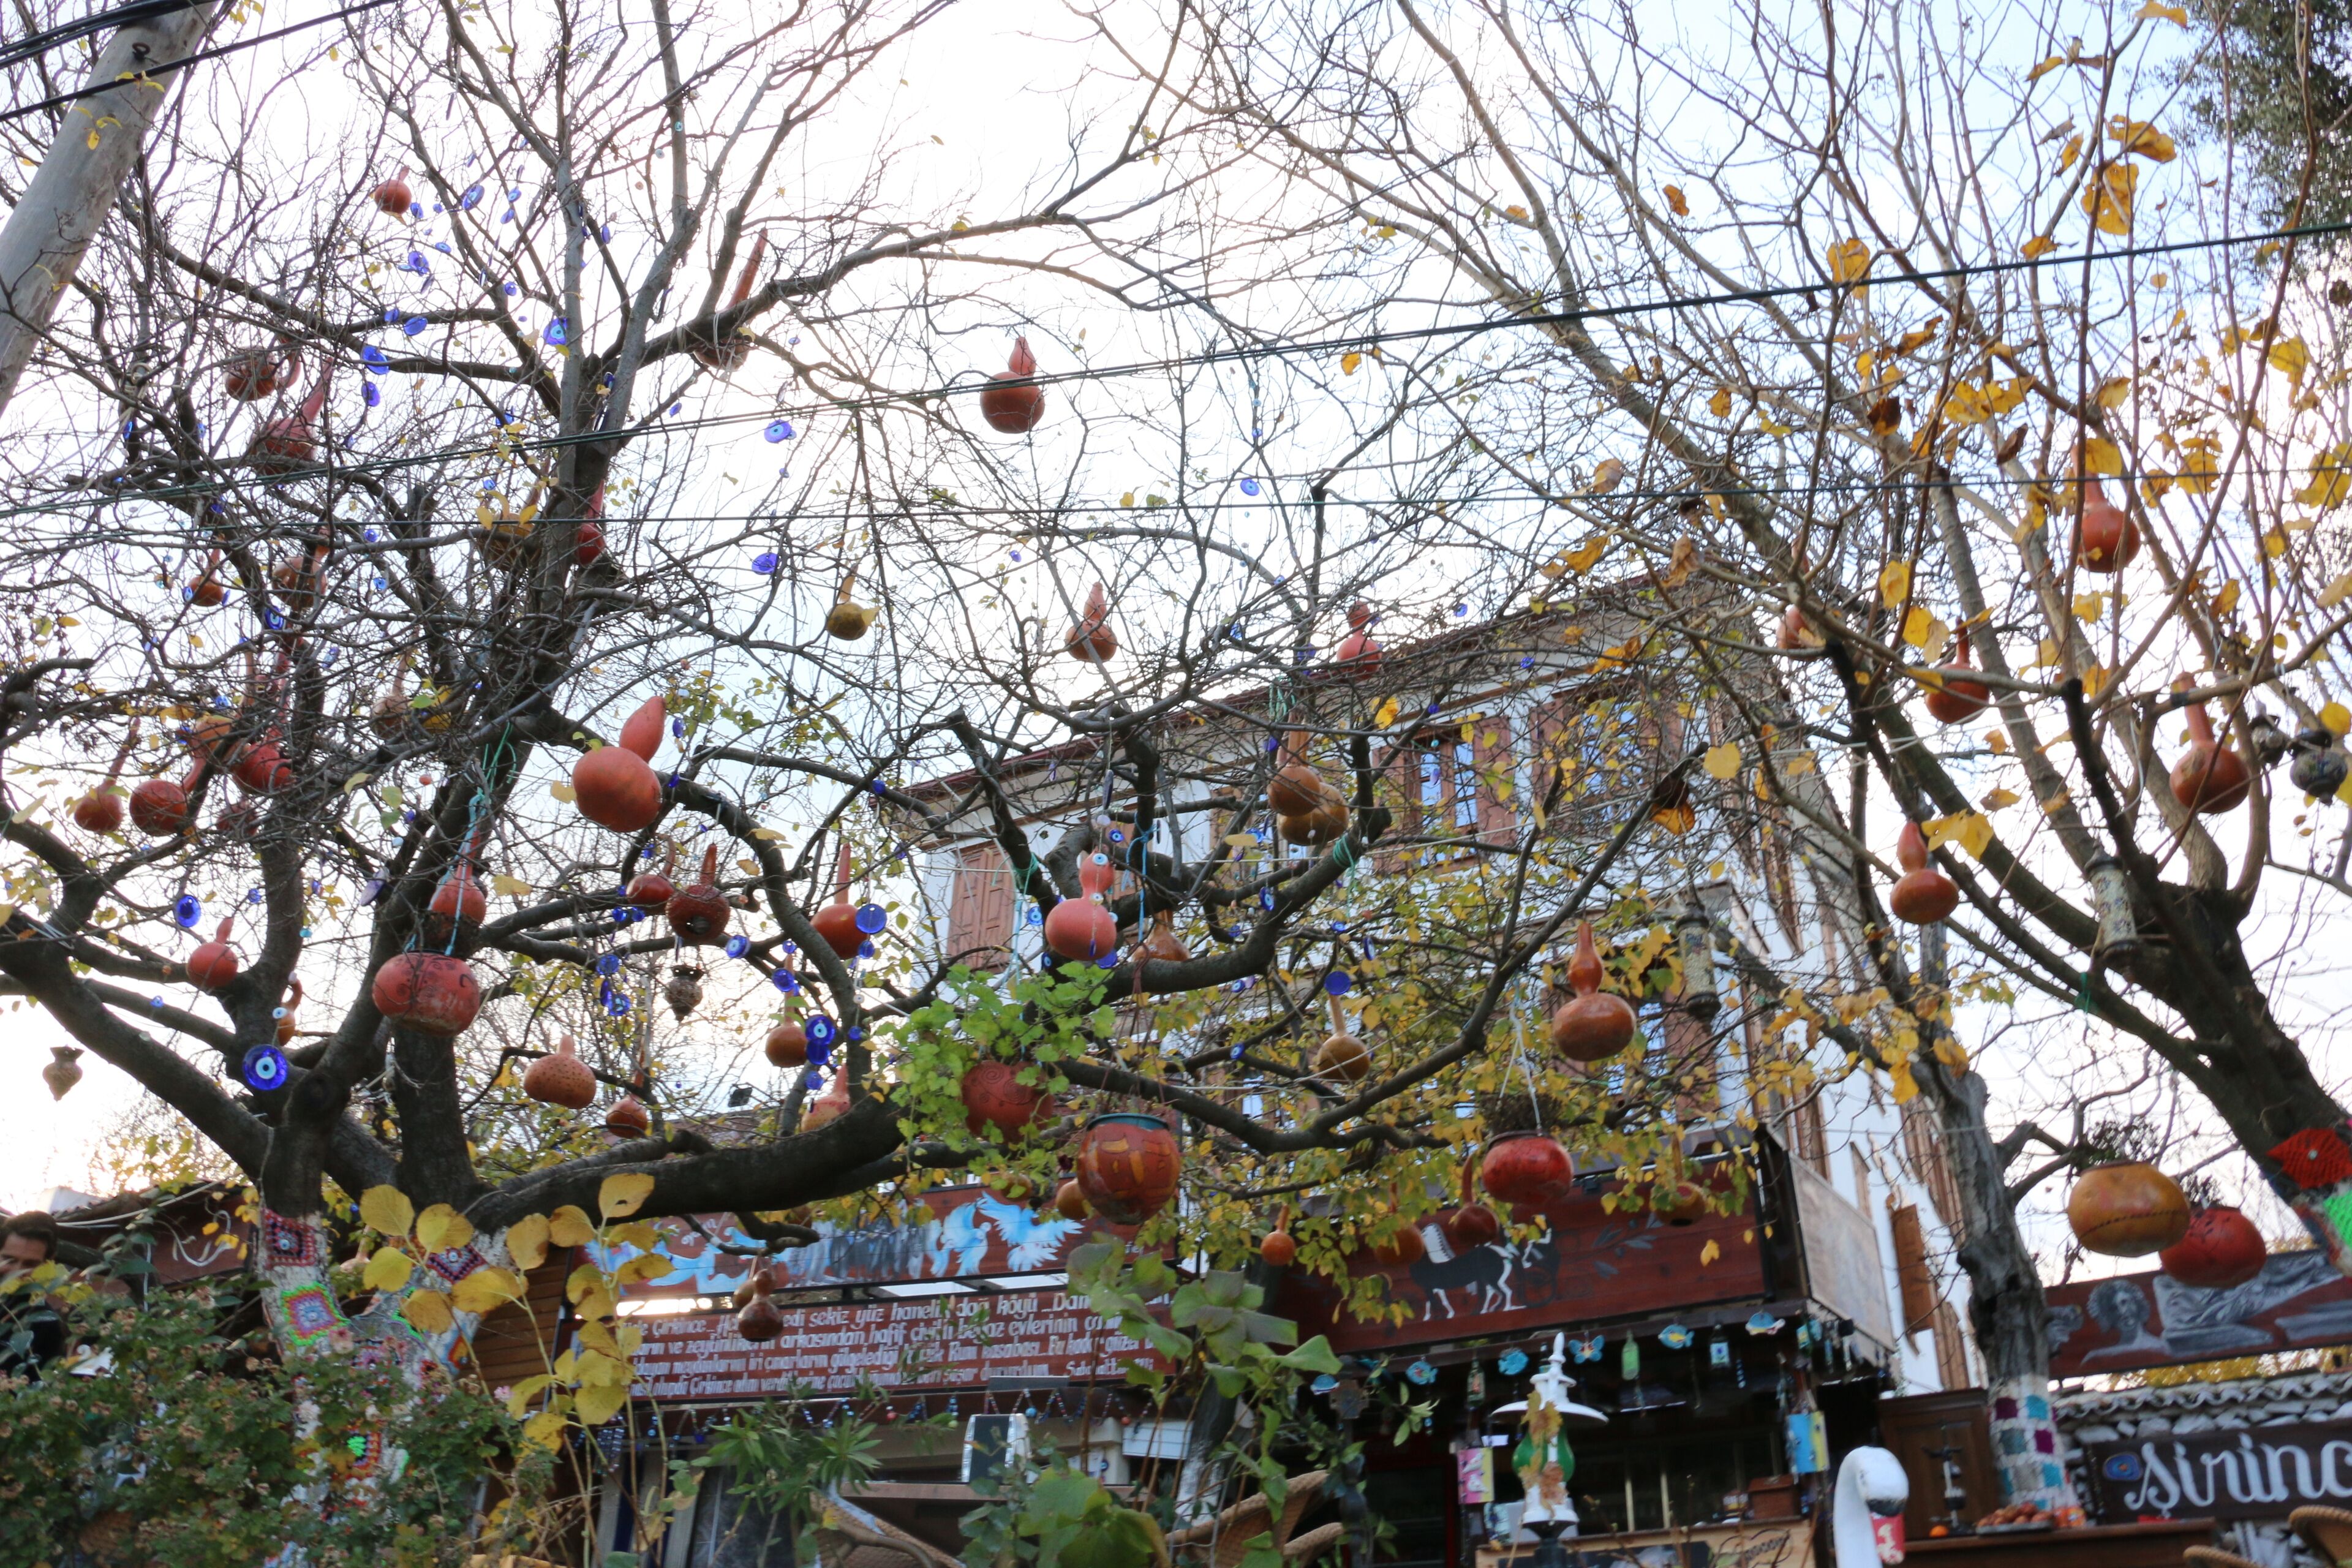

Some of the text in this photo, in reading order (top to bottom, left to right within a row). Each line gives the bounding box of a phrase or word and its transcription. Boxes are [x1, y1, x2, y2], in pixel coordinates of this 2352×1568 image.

[783, 1308, 805, 1327] edi
[809, 1306, 850, 1328] sekiz
[850, 1304, 885, 1330] yüz
[997, 1292, 1038, 1319] köyü
[869, 1321, 907, 1346] hafif
[958, 1318, 1005, 1344] beyaz
[1008, 1313, 1078, 1336] evlerinin
